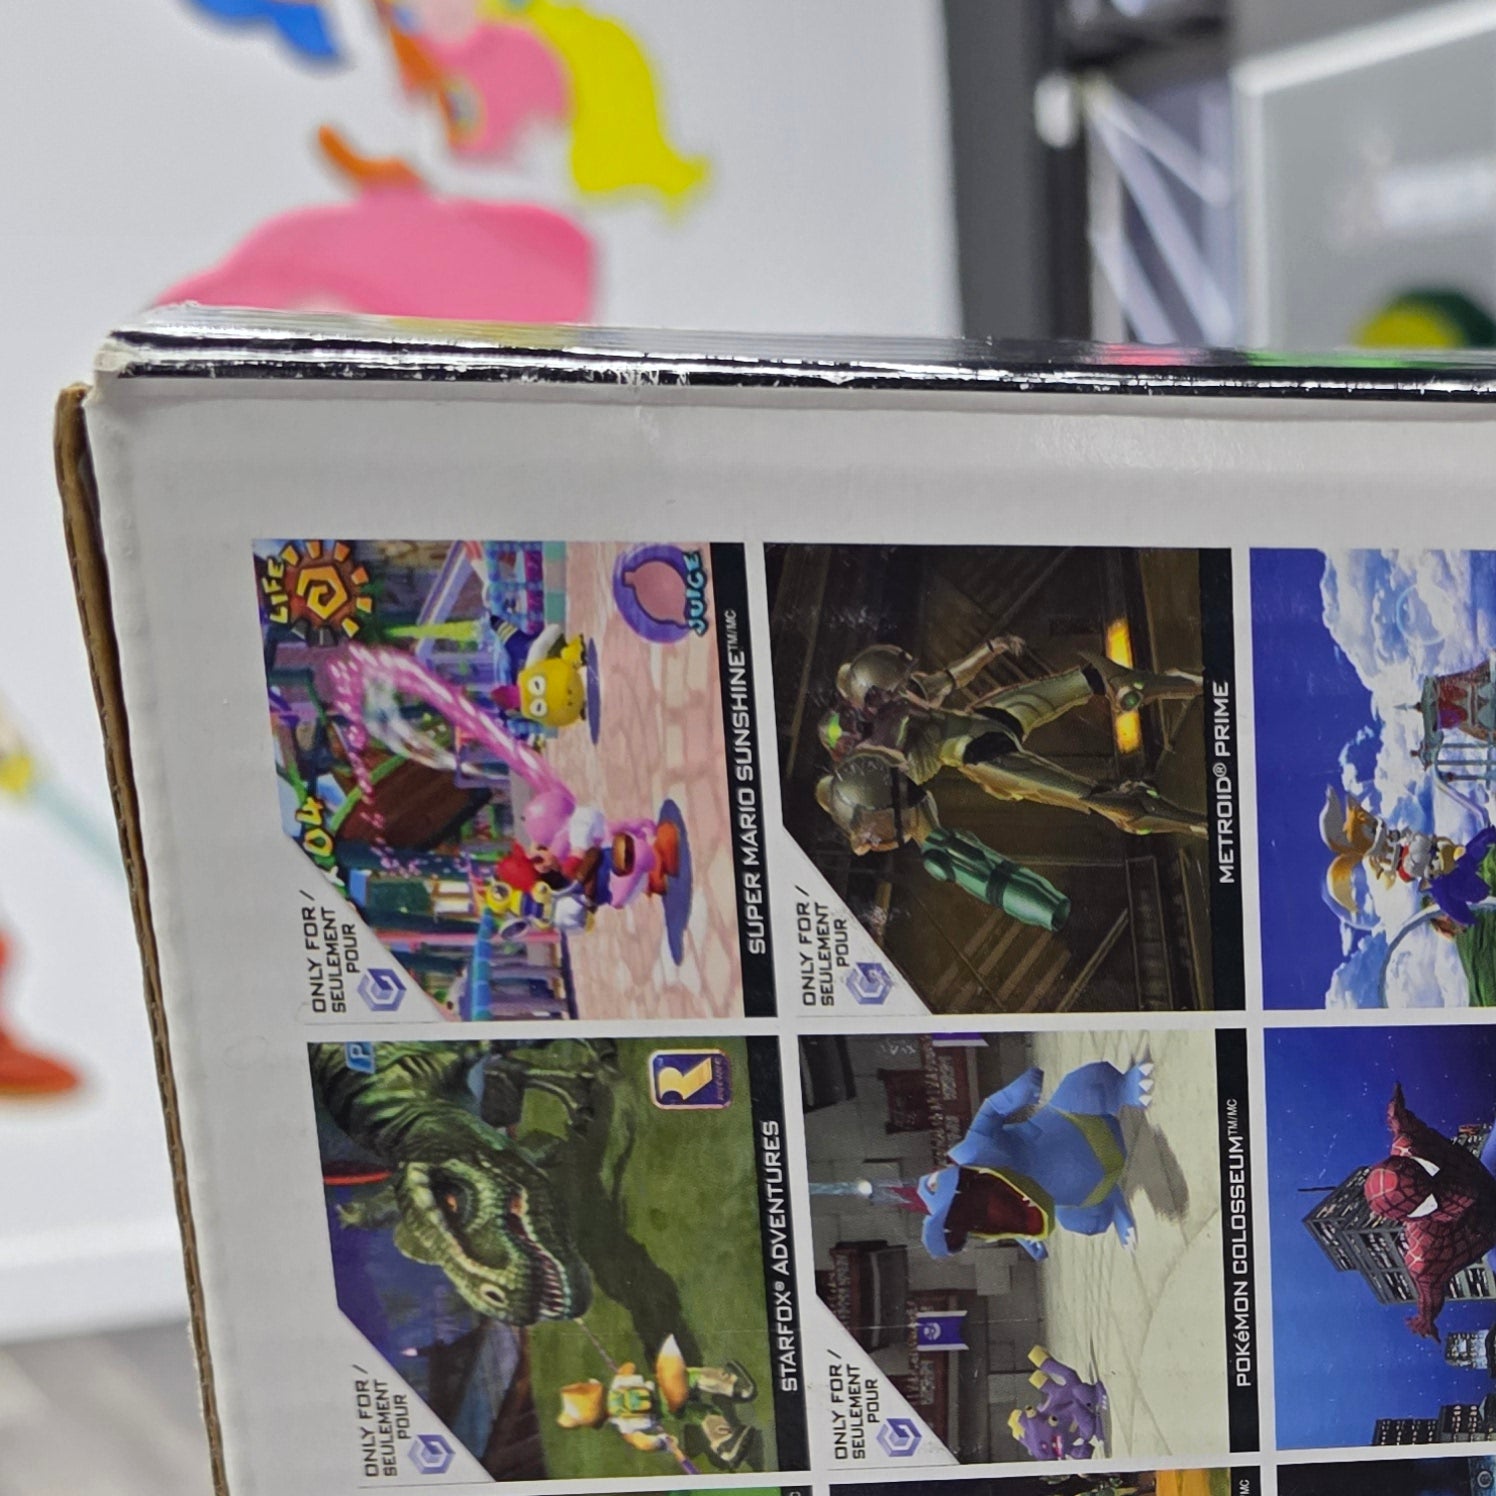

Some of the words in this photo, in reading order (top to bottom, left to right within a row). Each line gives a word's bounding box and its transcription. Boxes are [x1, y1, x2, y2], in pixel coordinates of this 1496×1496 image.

[260, 554, 289, 624] LIFE
[682, 550, 708, 636] JUICE
[1212, 681, 1231, 757] PRIME
[737, 787, 760, 866] MARIO
[300, 906, 321, 951] FOR
[340, 923, 361, 974] POUR
[743, 872, 767, 955] SUPER
[795, 901, 813, 945] FOR
[833, 918, 850, 968] POUR
[306, 957, 327, 1014] ONLY
[320, 906, 347, 1014] SEULEMENT
[799, 951, 817, 1007] ONLY
[814, 901, 835, 1007] SEULEMENT
[761, 1120, 790, 1276] ADVENTURES
[1233, 1280, 1252, 1387] POKéMON
